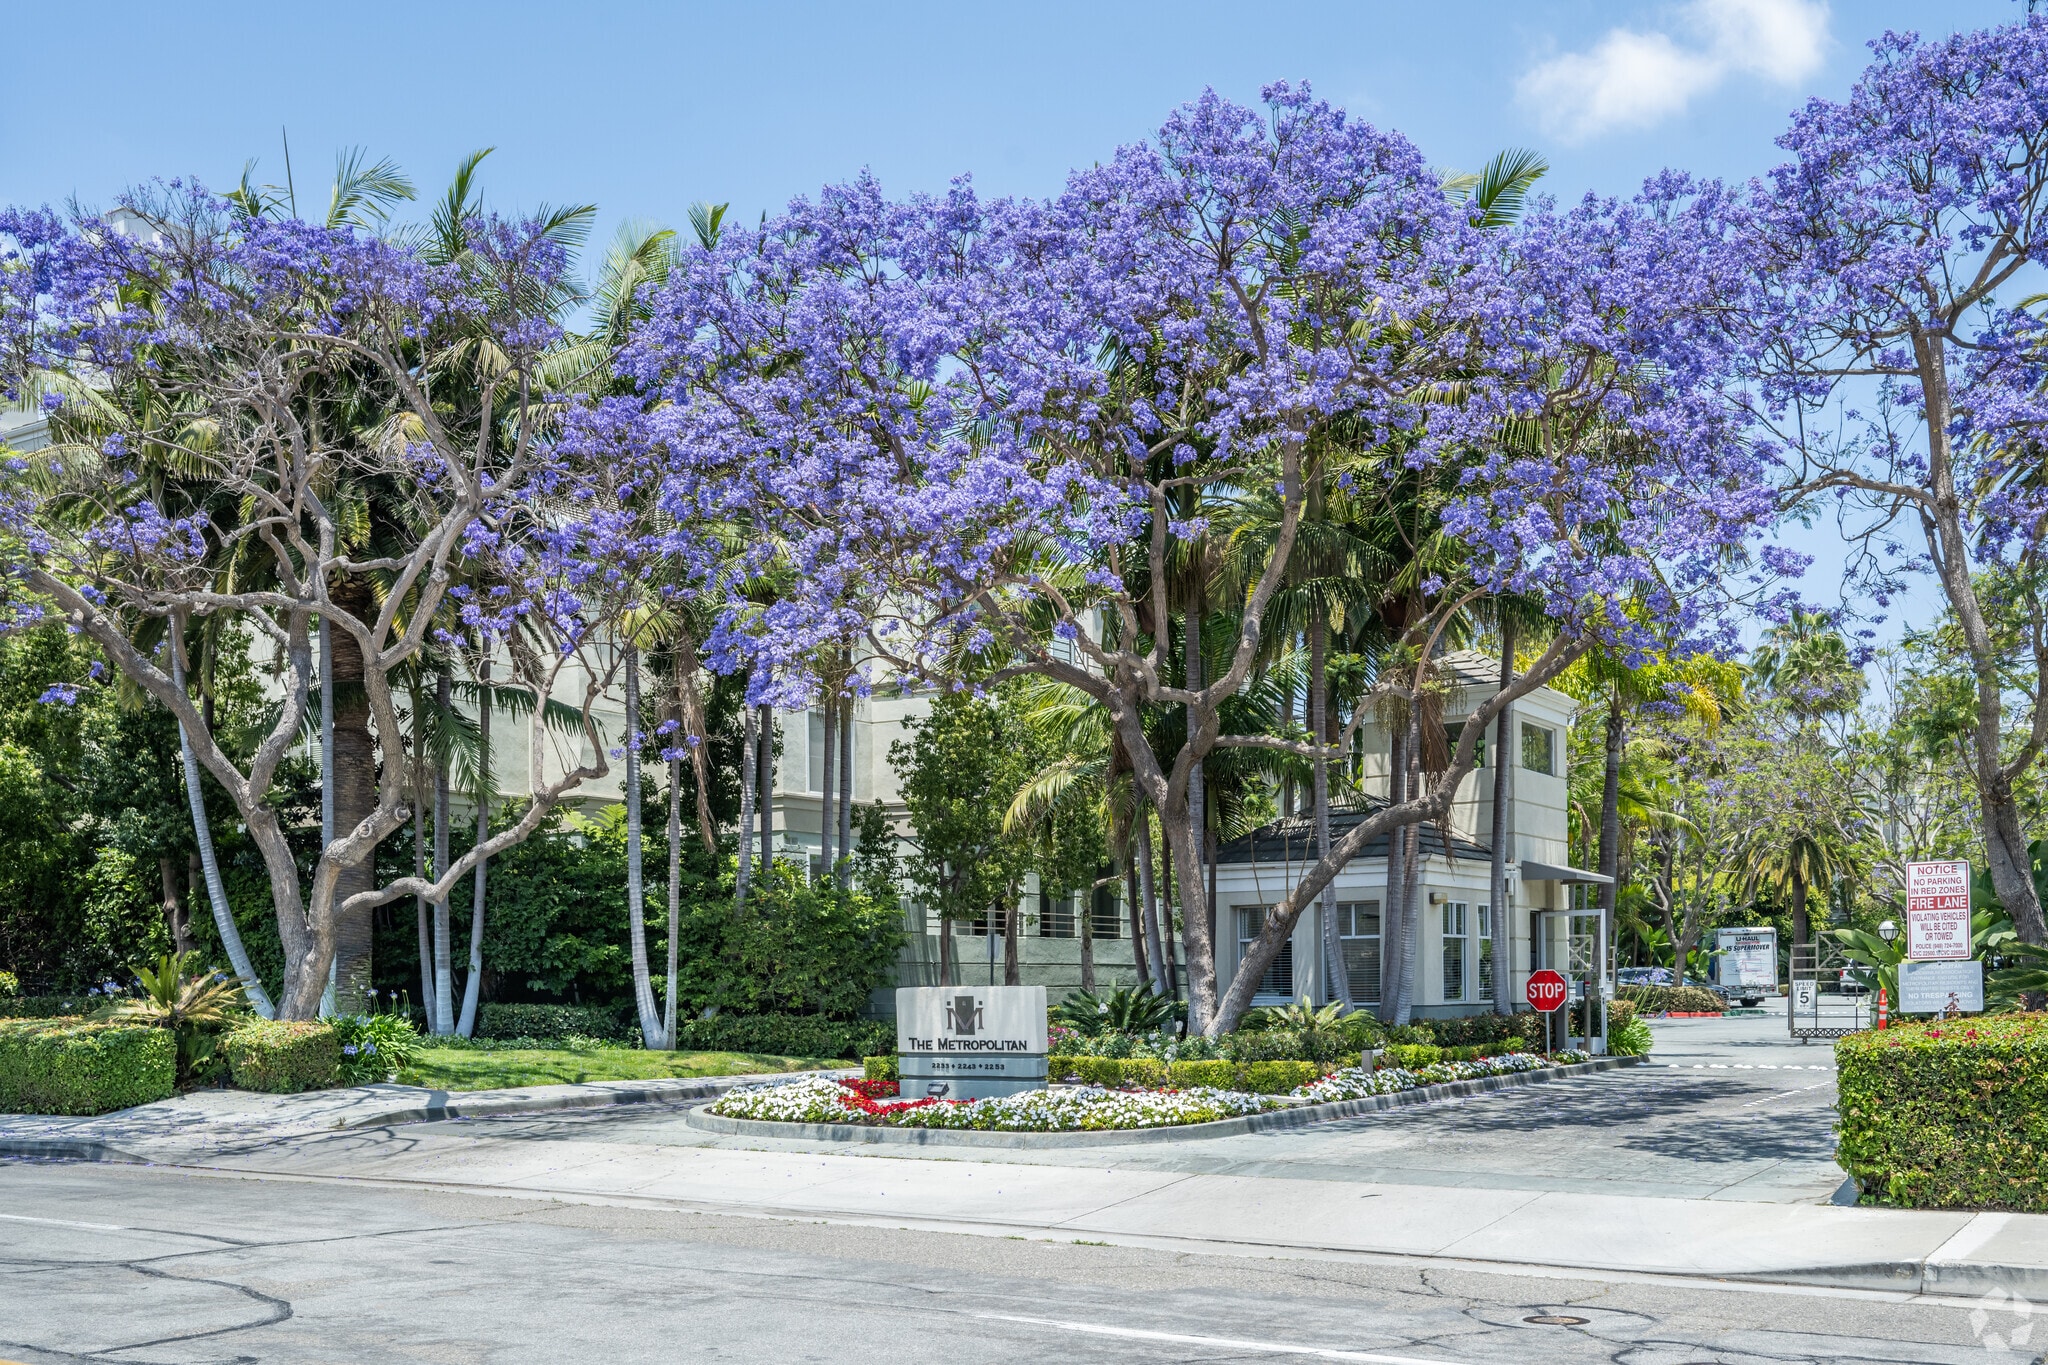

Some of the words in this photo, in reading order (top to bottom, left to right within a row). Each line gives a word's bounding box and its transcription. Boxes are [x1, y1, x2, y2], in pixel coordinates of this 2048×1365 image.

[1917, 865, 1958, 875] NOTICE
[1913, 878, 1925, 886] NO
[1927, 877, 1962, 885] PARKING
[1921, 887, 1937, 895] RED
[1939, 885, 1966, 894] ZONES
[1910, 897, 1934, 909] FIRE
[1937, 896, 1967, 908] LANE
[1911, 912, 1940, 921] VIOLATING
[1940, 911, 1966, 920] VEHICLES
[1920, 923, 1933, 931] WILL
[1934, 922, 1941, 930] BE
[1942, 922, 1958, 930] CITED
[1925, 932, 1934, 941] OR
[1934, 931, 1953, 940] TOWED
[1528, 982, 1564, 999] STOP
[1920, 991, 1974, 999] TRESPAING
[1799, 991, 1809, 1004] 5
[908, 1037, 933, 1050] THE
[938, 1037, 1028, 1051] METROPOLITAN
